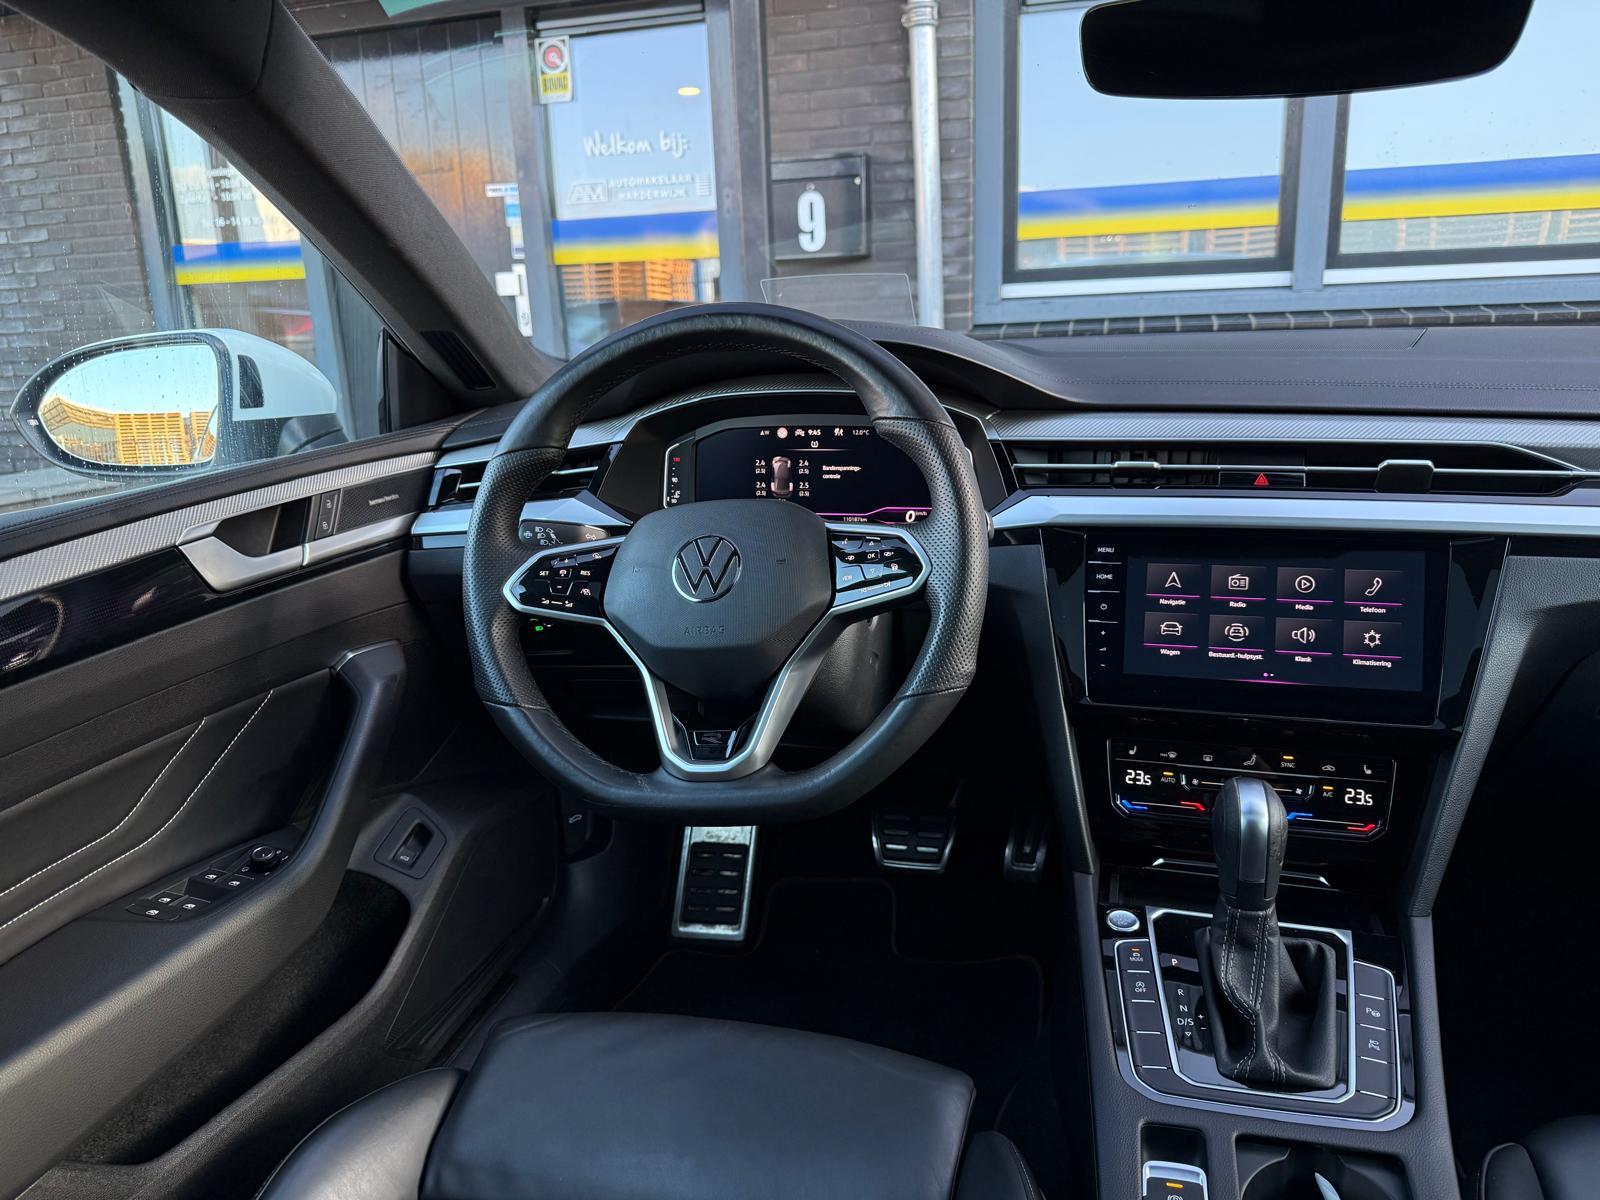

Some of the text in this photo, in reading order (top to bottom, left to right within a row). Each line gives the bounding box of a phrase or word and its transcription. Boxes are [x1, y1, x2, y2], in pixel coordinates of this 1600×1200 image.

[583, 129, 689, 158] Welkom bij:
[798, 191, 826, 252] 9
[905, 510, 915, 522] 0
[1159, 598, 1186, 606] Navigatie
[1360, 606, 1386, 614] Telefoon
[1160, 648, 1180, 656] Wagen
[1352, 658, 1392, 668] Klimatisering
[1125, 769, 1152, 786] 23.5
[1344, 788, 1374, 806] 23.5
[1171, 958, 1179, 966] P
[1177, 988, 1185, 996] R
[1176, 1018, 1195, 1026] D/S
